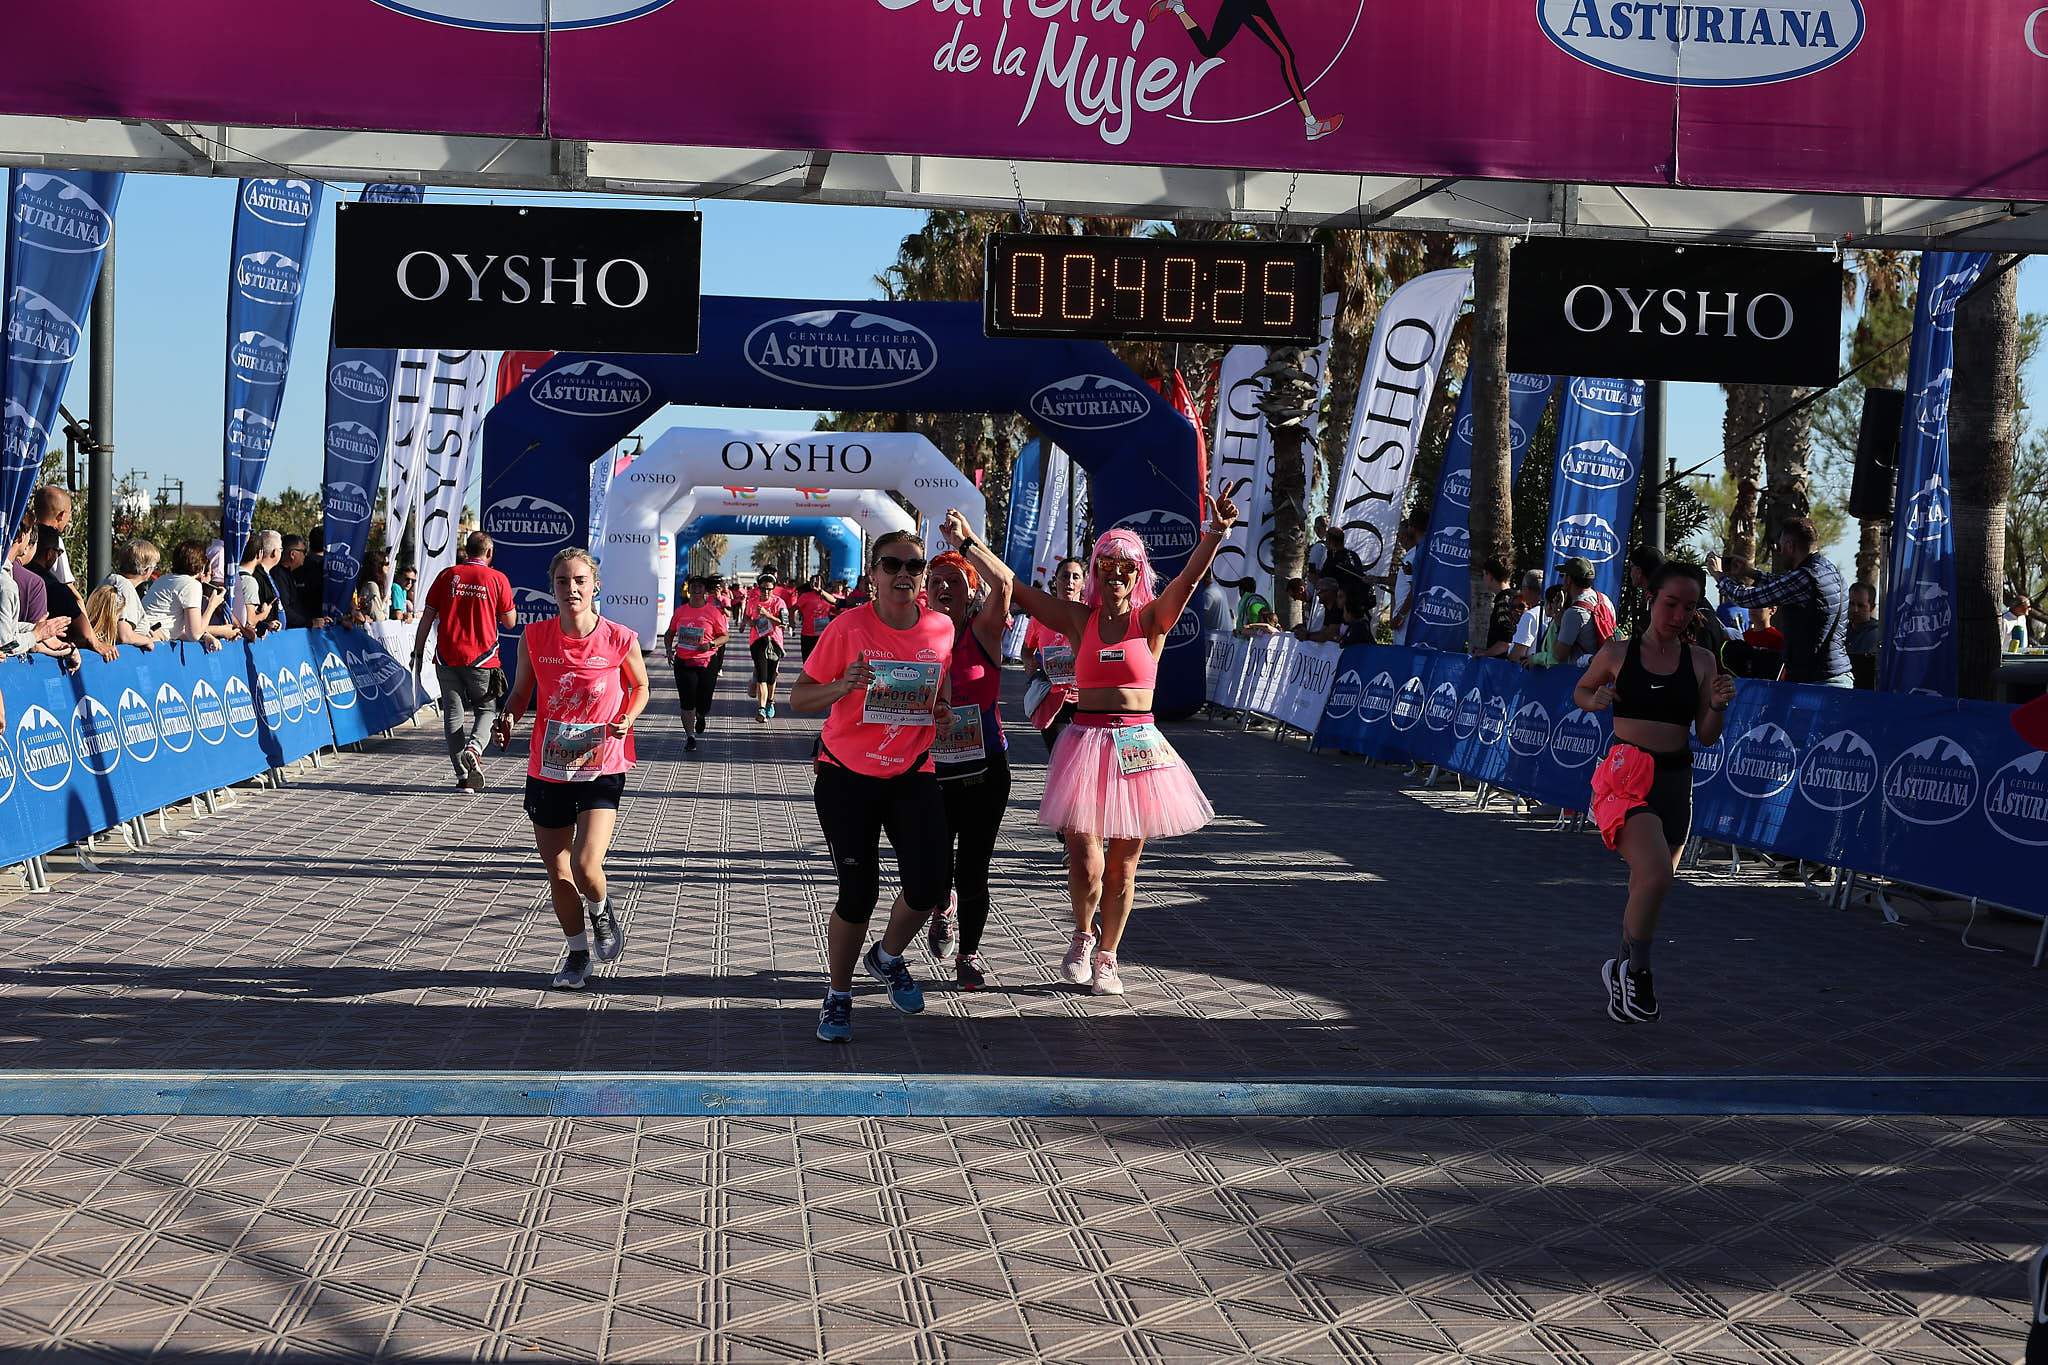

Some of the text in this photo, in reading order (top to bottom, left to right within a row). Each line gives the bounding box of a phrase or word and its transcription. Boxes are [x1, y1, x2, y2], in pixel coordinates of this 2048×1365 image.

[1562, 0, 1840, 49] ASTURIANA
[932, 20, 1226, 146] de la Mujer
[396, 251, 650, 309] OYSHO
[1011, 252, 1295, 327] 00:40:25
[1563, 284, 1795, 341] OYSHO
[758, 331, 924, 371] ASTURIANA
[789, 331, 917, 344] CENTRAL LECHERA
[536, 380, 642, 403] ASTURIANA
[1040, 396, 1143, 416] ASTURIANA
[721, 440, 873, 474] OYSHO
[630, 473, 677, 485] OYSHO
[914, 478, 960, 488] OYSHO
[486, 513, 569, 535] ASTURIANA
[608, 533, 651, 544] OYSHO
[606, 594, 649, 606] OYSHO
[538, 656, 565, 665] OYSHO
[863, 649, 894, 659] OYSHO
[22, 740, 71, 773] ASTURIANA
[76, 728, 119, 759] ASTURIANA
[1553, 727, 1596, 755] ASTURIANA
[1729, 748, 1790, 782] ASTURIANA
[1803, 757, 1869, 793] ASTURIANA
[1888, 765, 1969, 807] ASTURIANA
